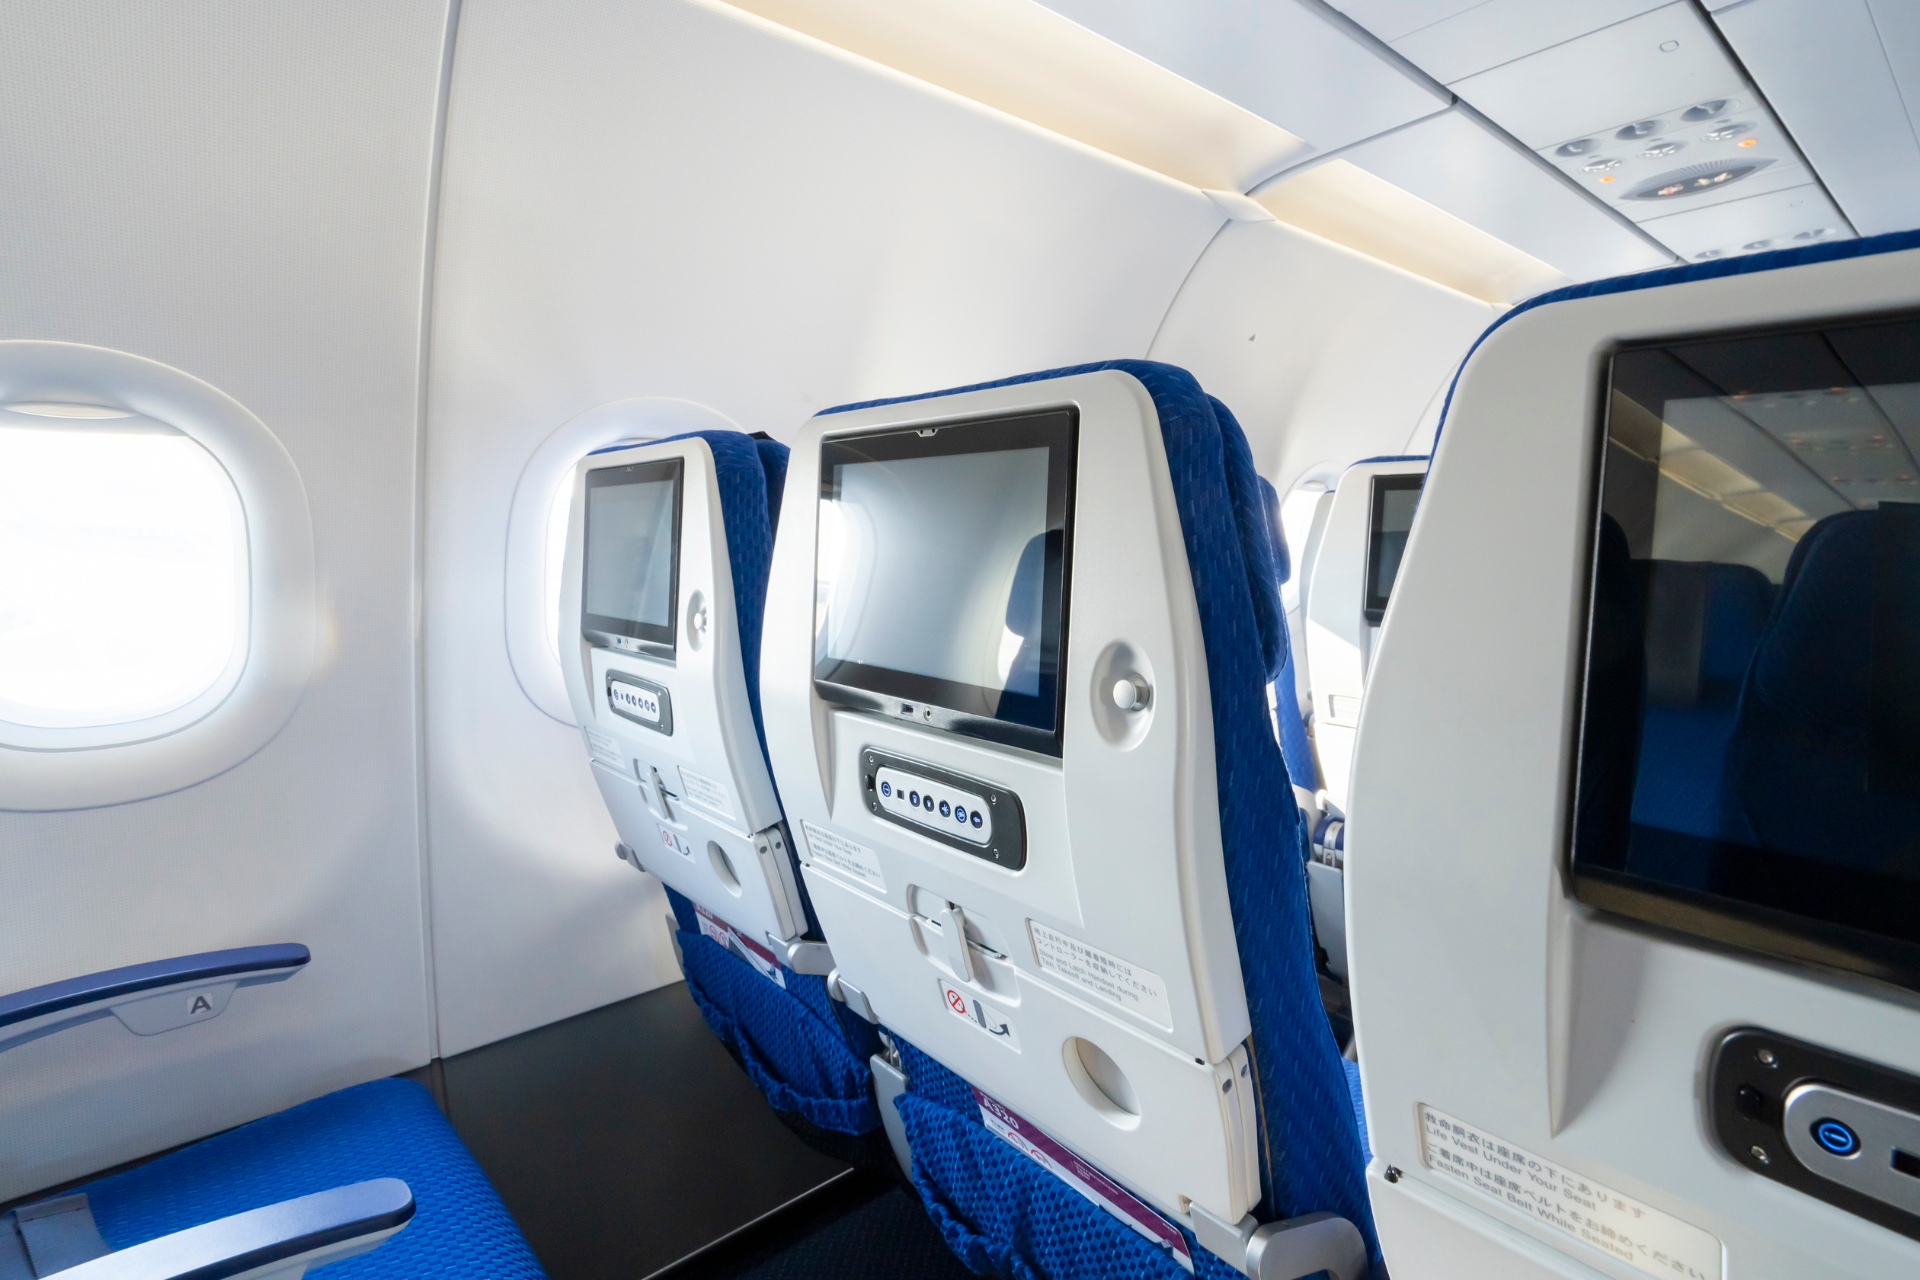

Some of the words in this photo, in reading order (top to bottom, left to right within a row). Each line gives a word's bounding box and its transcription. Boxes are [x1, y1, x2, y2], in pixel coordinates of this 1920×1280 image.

[1056, 957, 1067, 966] and
[1088, 971, 1115, 989] Handset
[1116, 984, 1139, 1002] during
[1057, 963, 1080, 980] Takeoff
[1082, 977, 1094, 987] and
[1095, 982, 1122, 1002] Landing
[190, 995, 212, 1015] A
[983, 1097, 1020, 1130] A320
[1425, 1112, 1646, 1219] 救命胴衣は座席の下にあります
[1426, 1124, 1448, 1140] Life
[1451, 1135, 1479, 1155] Vest
[1483, 1151, 1523, 1175] Under
[1527, 1171, 1558, 1192] Your
[1563, 1188, 1597, 1211] Seat
[1429, 1154, 1469, 1180] Fasten
[1473, 1176, 1503, 1197] Seat
[1506, 1191, 1533, 1212] Belt
[1537, 1207, 1576, 1233] While
[1581, 1228, 1634, 1262] Seated
